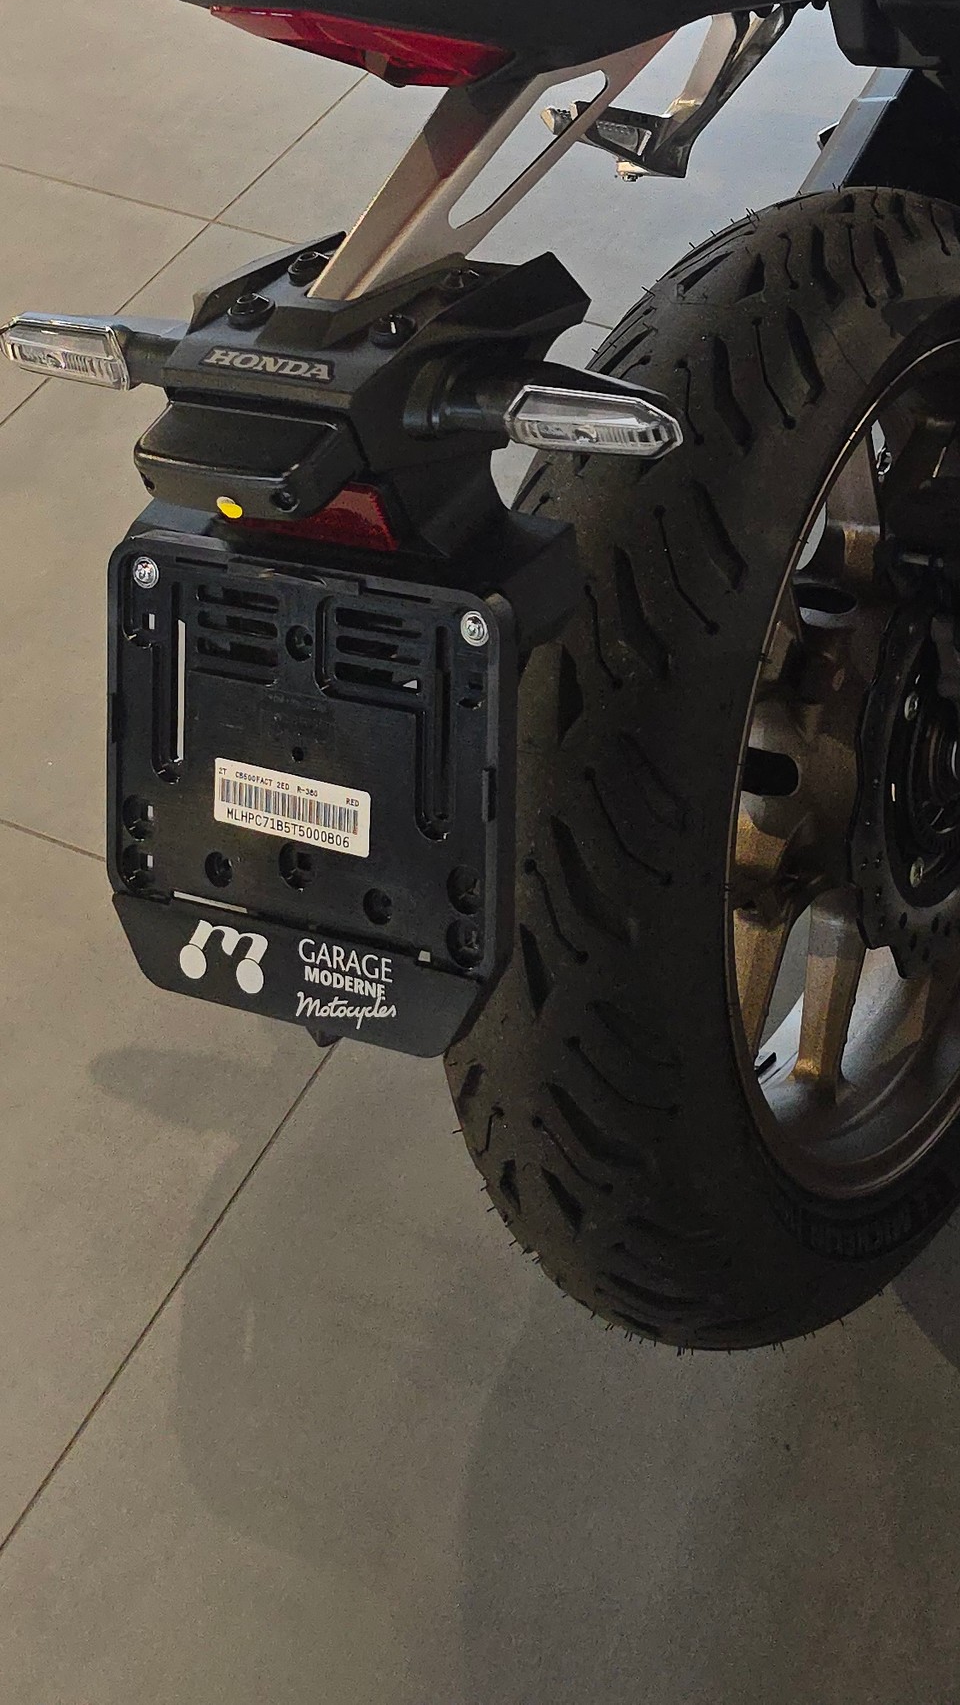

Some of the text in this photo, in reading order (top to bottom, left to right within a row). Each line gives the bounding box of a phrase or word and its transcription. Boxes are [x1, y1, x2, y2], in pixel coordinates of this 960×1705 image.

[203, 349, 330, 380] HONDA
[218, 767, 227, 775] 2T
[345, 797, 360, 807] RED
[298, 938, 393, 983] GARAGE
[304, 965, 386, 1000] MODERNE
[295, 991, 397, 1030] Motocycles
